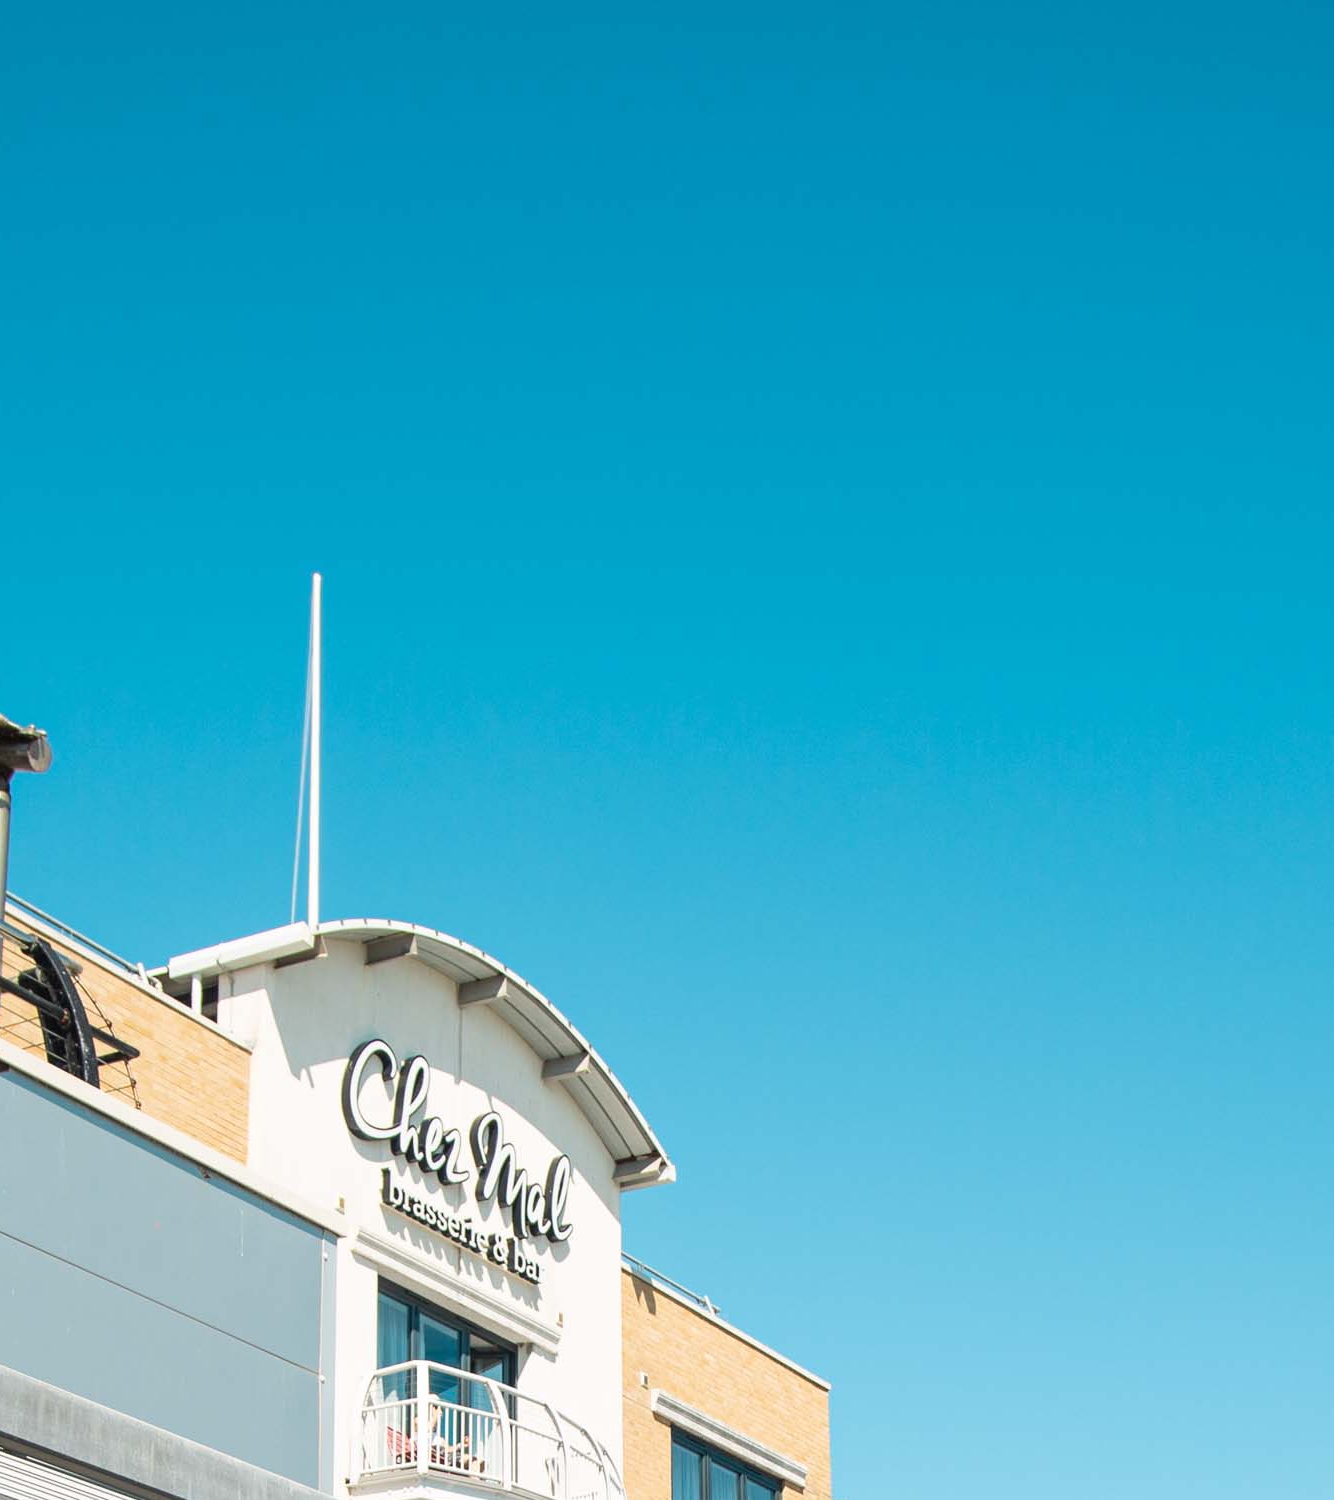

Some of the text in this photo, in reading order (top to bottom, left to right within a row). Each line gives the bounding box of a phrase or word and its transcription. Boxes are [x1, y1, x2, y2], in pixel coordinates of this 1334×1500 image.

[341, 1039, 573, 1242] Chez Mal
[379, 1167, 544, 1284] brasserie & bar
